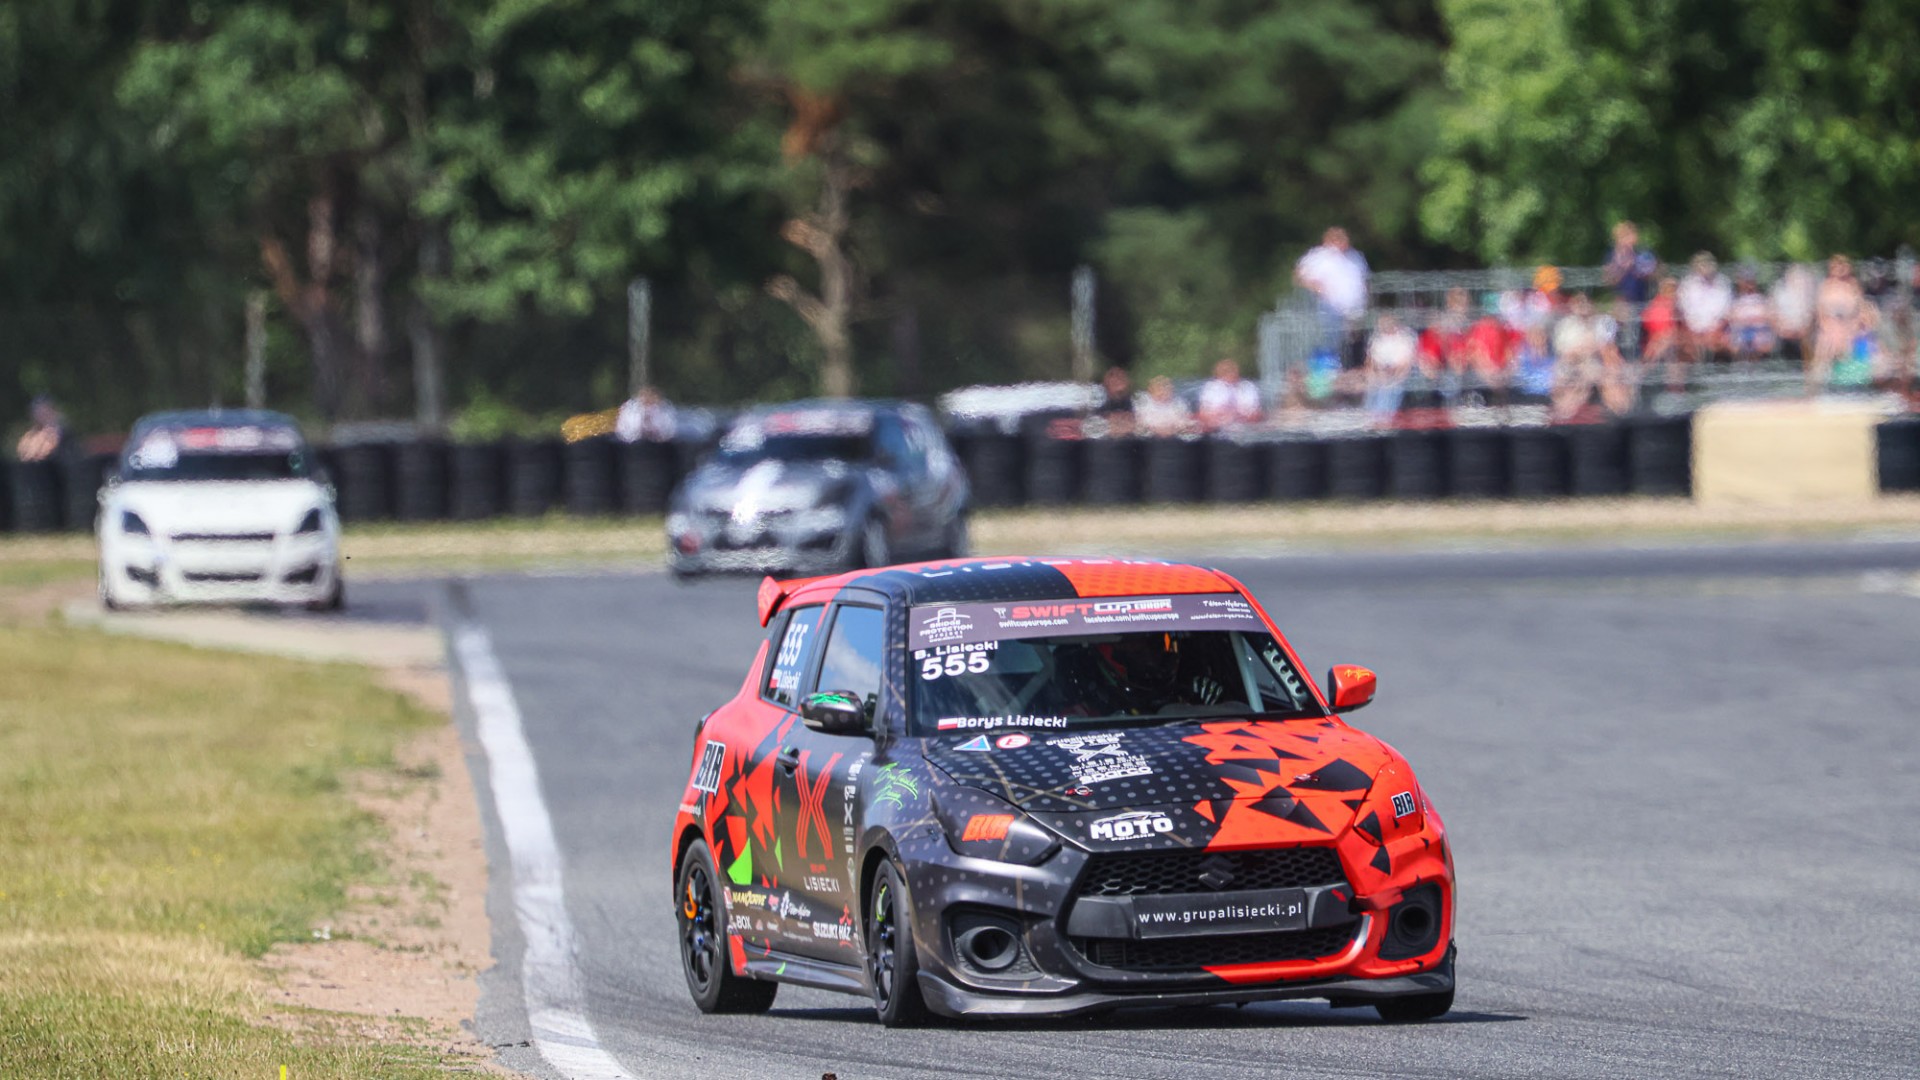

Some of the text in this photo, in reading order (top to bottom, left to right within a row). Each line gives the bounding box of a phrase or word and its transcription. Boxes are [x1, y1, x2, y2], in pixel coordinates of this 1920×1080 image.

[1012, 603, 1093, 618] SWIFT
[1094, 601, 1131, 614] CUP
[919, 624, 973, 636] PROTECTION
[930, 619, 961, 629] BRIDGE
[999, 619, 1068, 629] swiftcupeurope.com
[778, 623, 809, 667] 555
[914, 640, 999, 660] B. Lisiecki
[921, 651, 990, 681] 555
[957, 714, 1067, 729] Borys Lisiecki
[1080, 766, 1153, 785] sparco
[1391, 791, 1415, 818] BIR
[1090, 817, 1174, 840] MOTO
[803, 876, 840, 893] LISIECKI
[1138, 902, 1302, 923] www.grupalisiecki.pl
[812, 921, 839, 939] SUZUKI
